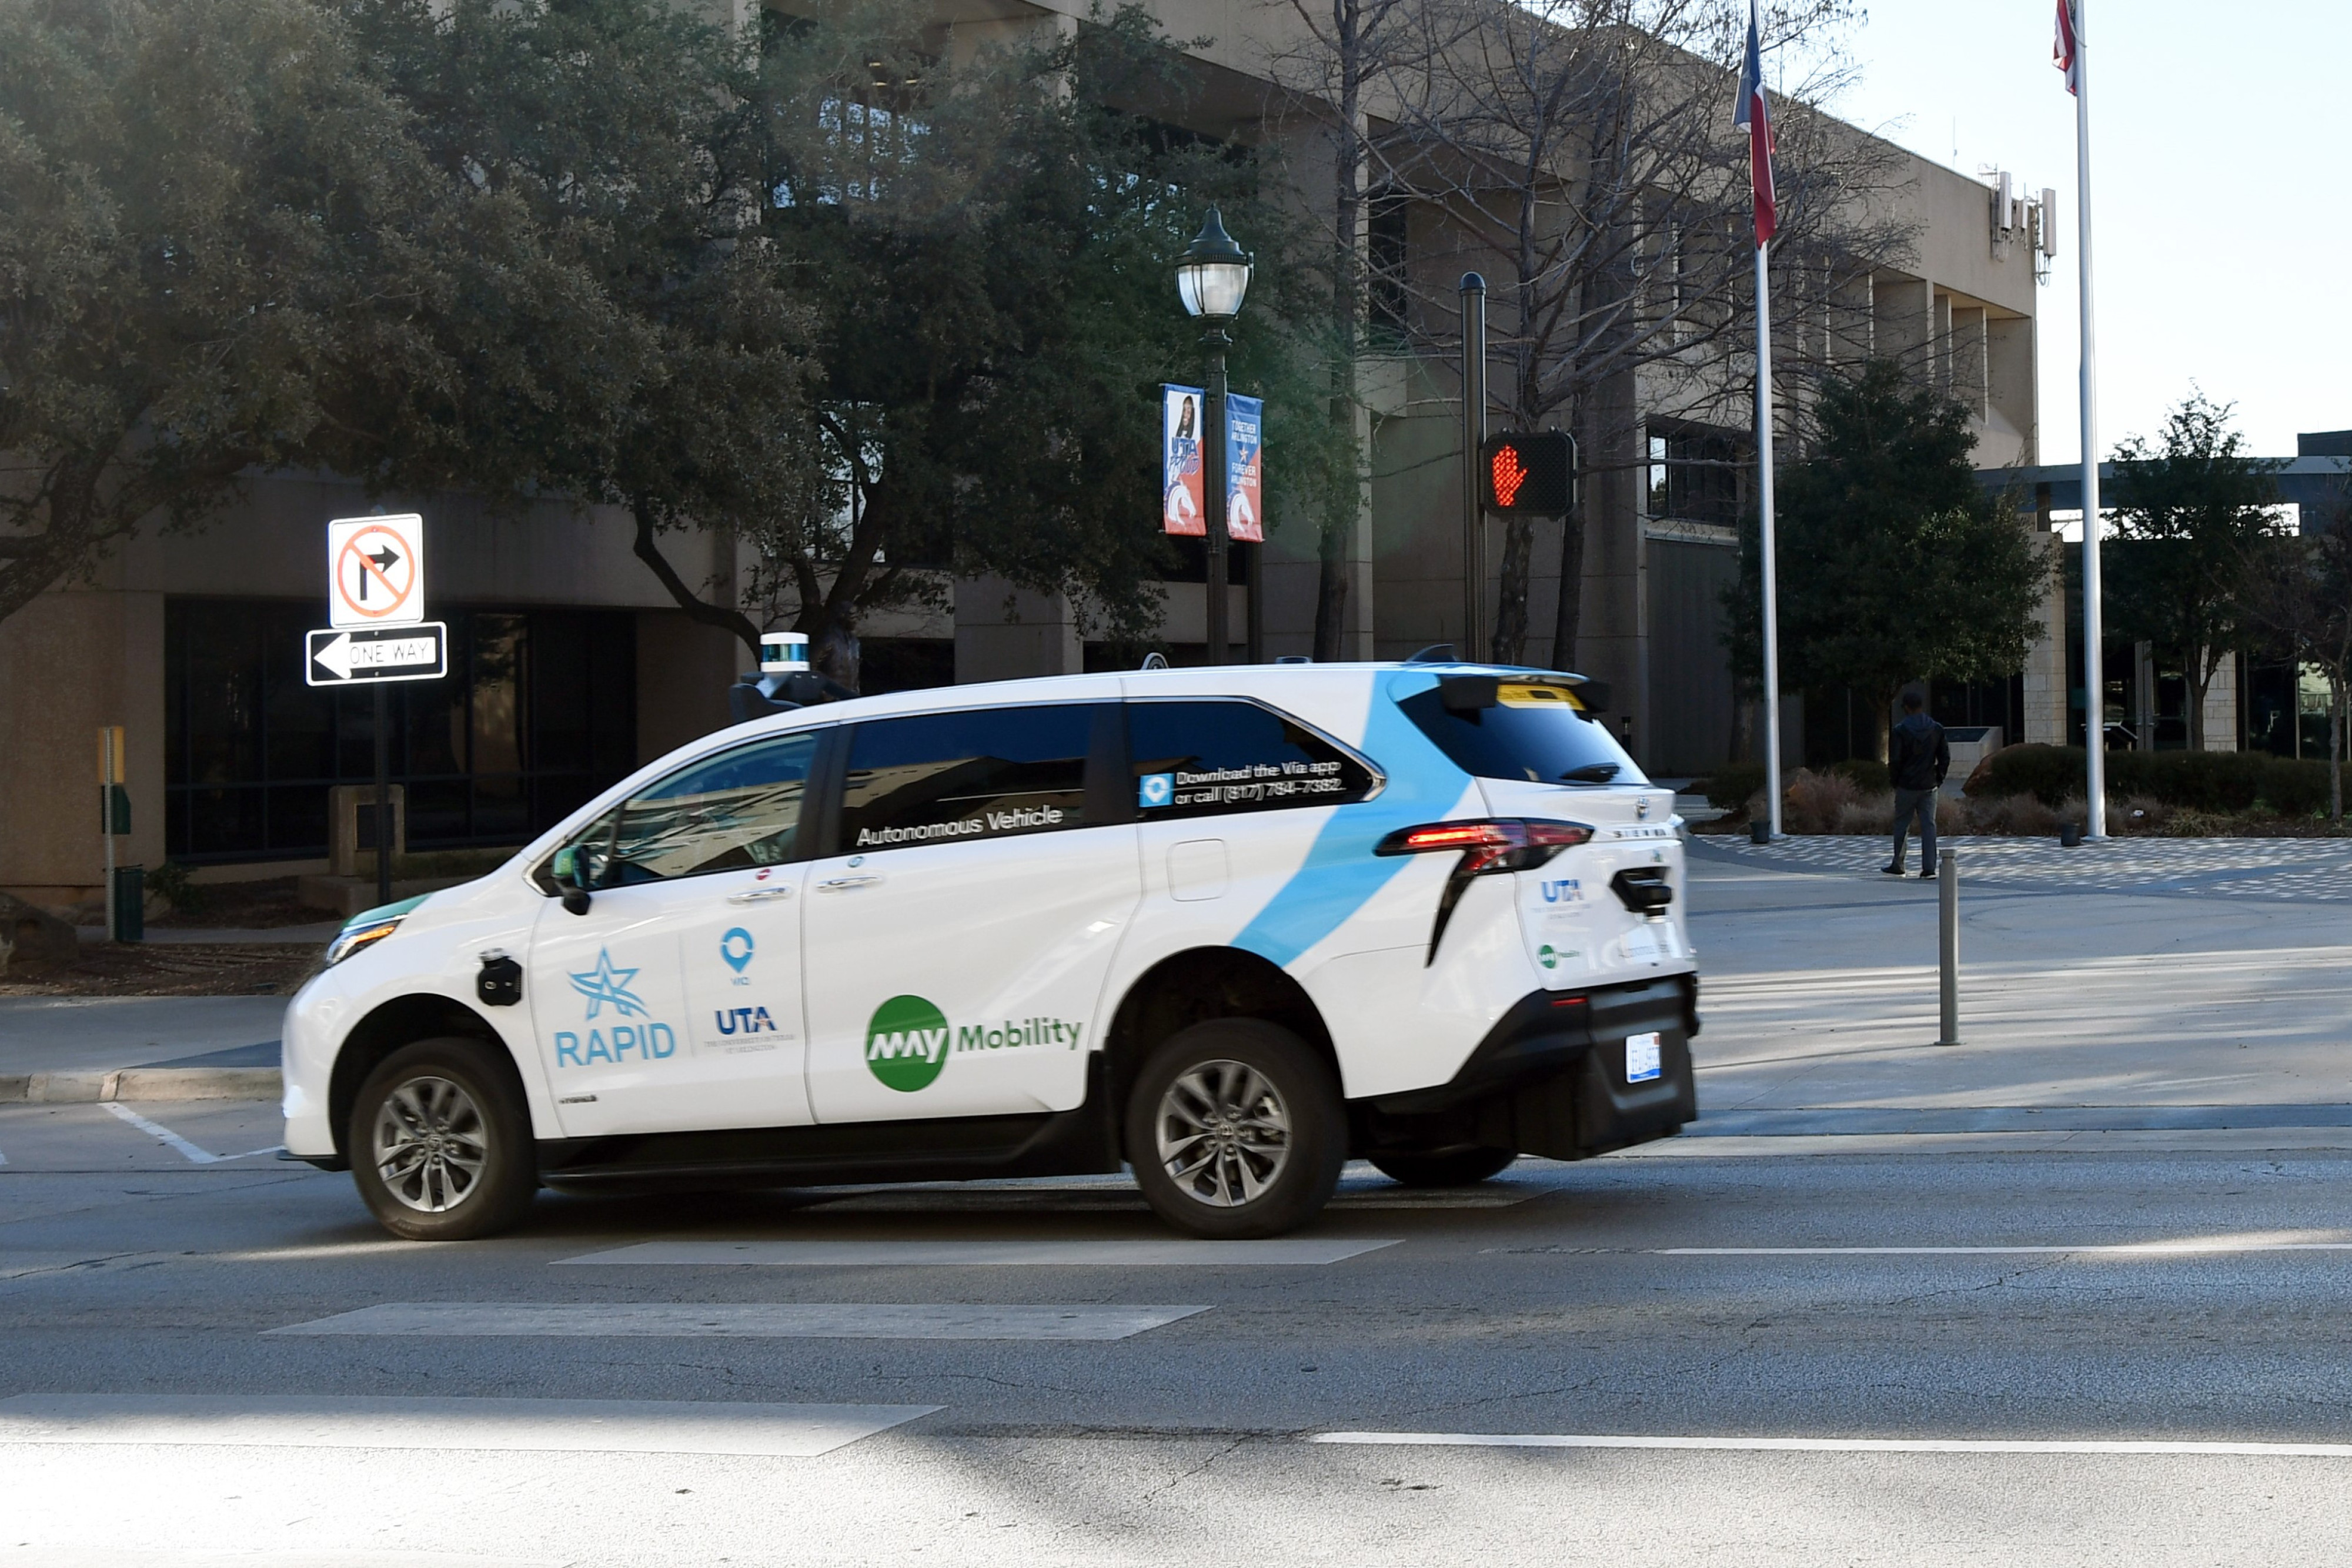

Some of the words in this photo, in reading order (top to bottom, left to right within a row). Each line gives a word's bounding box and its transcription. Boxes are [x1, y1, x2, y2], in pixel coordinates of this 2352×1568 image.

[1231, 420, 1256, 434] TOGETHER
[1231, 431, 1257, 444] ARLINGTON
[1171, 437, 1198, 456] UTA
[1168, 456, 1200, 475] PROUD
[1231, 462, 1256, 476] FOREVER
[1231, 474, 1257, 487] ARLINGTON
[350, 644, 384, 664] ONE
[392, 641, 428, 661] WAY
[1176, 764, 1252, 785] Download
[1253, 763, 1280, 777] the
[1281, 761, 1308, 775] Via
[1309, 761, 1342, 776] app
[1175, 795, 1192, 804] or
[1194, 786, 1222, 803] call
[1223, 783, 1264, 804] (817)
[857, 818, 984, 847] Autonomous
[986, 804, 1063, 830] Vehicle
[1541, 879, 1584, 902] UTA
[715, 1006, 778, 1035] UTA
[554, 1022, 676, 1068] RAPID
[956, 1017, 1084, 1052] Mobility
